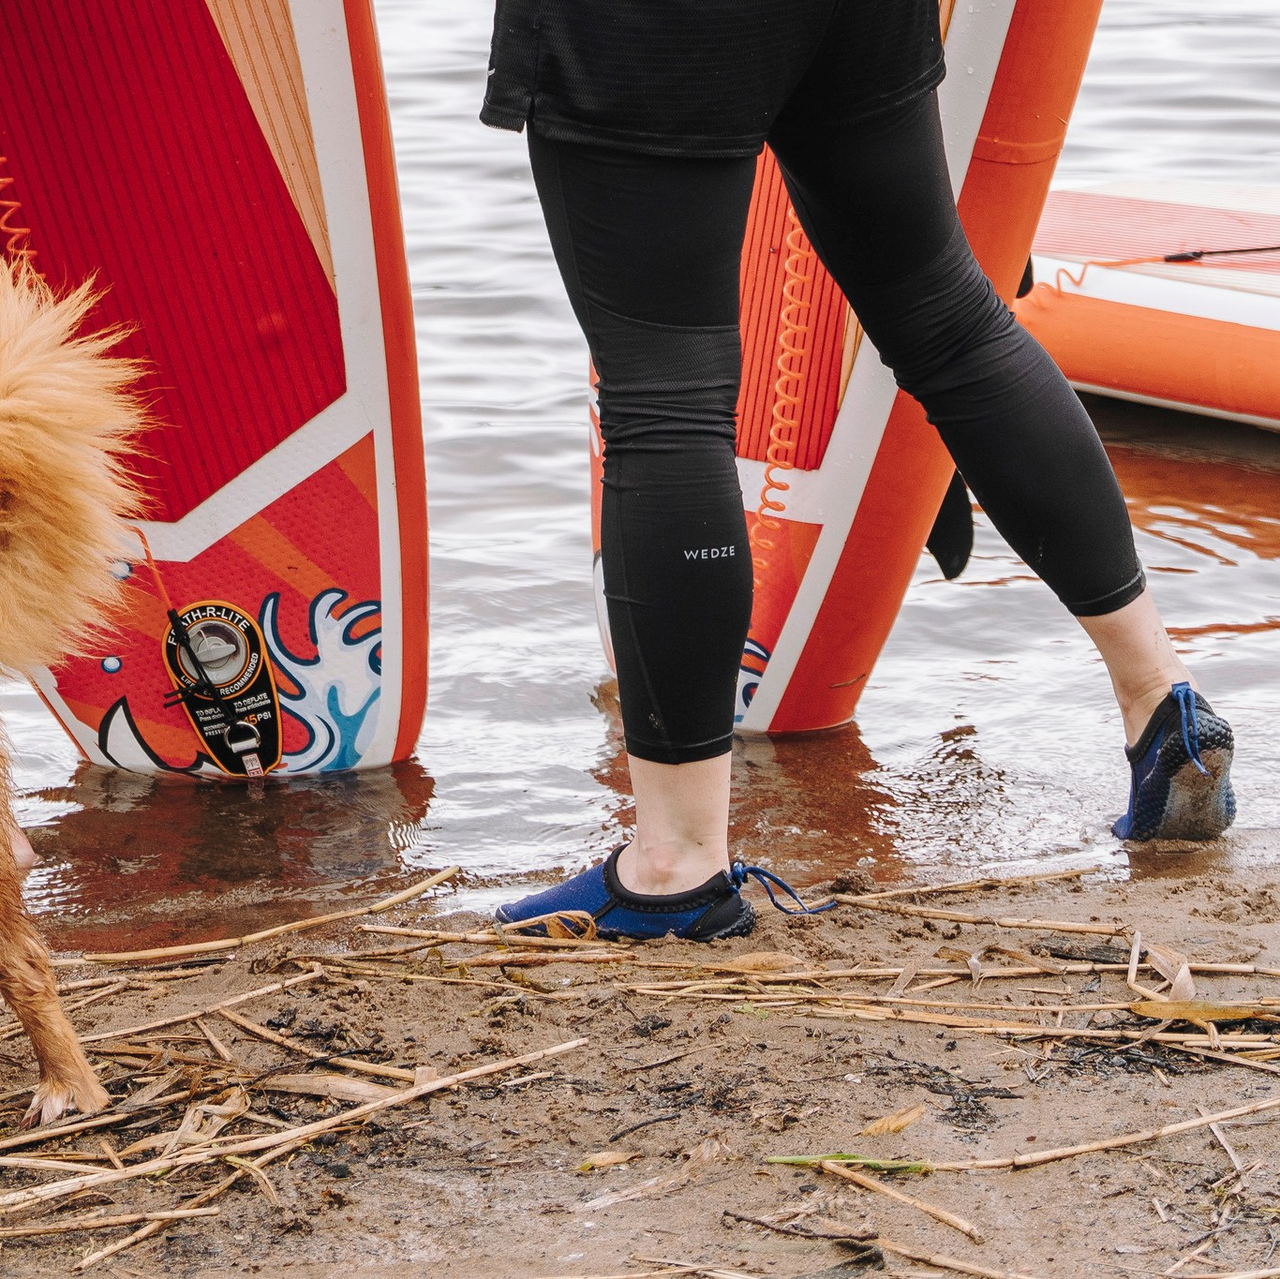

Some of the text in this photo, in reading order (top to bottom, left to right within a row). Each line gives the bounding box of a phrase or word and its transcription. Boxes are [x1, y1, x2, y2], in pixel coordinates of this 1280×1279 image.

[683, 545, 736, 560] WEDZE
[168, 606, 250, 646] FTH-R-LITE
[219, 652, 259, 696] RECOMMENDED
